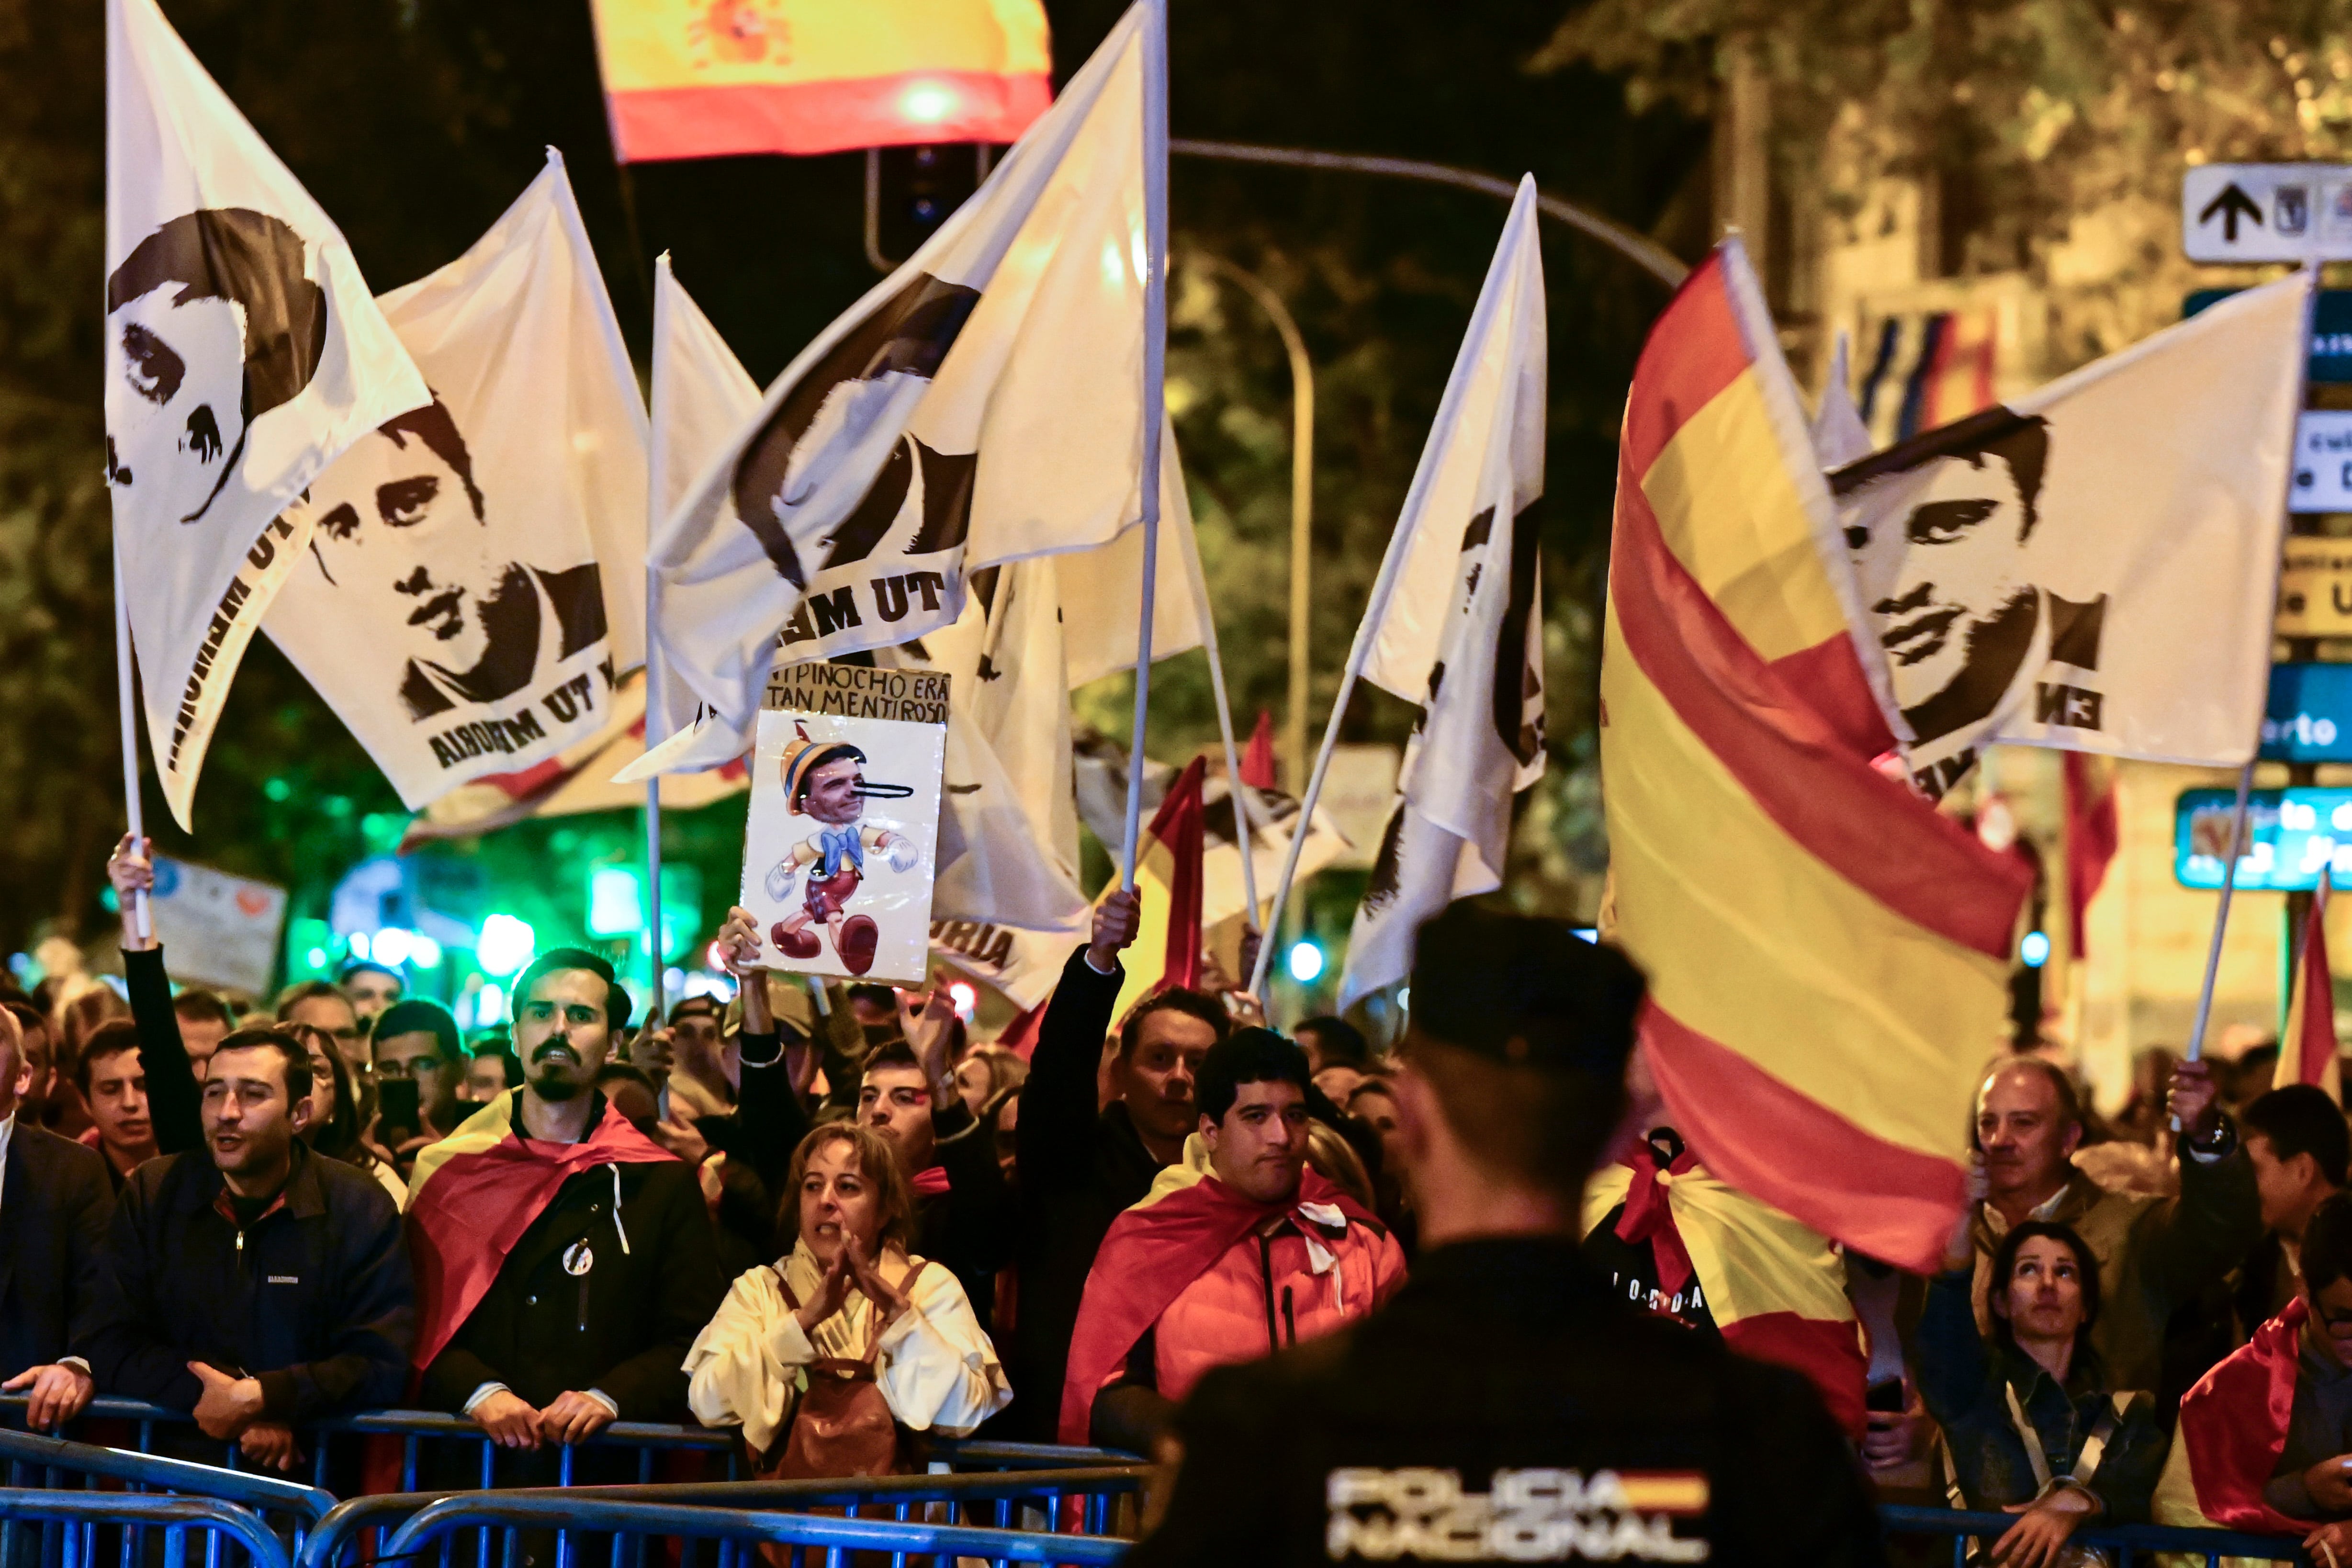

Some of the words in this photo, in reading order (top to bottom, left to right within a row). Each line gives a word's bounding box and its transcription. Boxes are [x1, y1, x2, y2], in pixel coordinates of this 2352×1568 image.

[796, 663, 906, 699] PINOCHO
[913, 678, 948, 700] ERA
[767, 686, 813, 711] TAN
[820, 690, 947, 724] MENTIROSO
